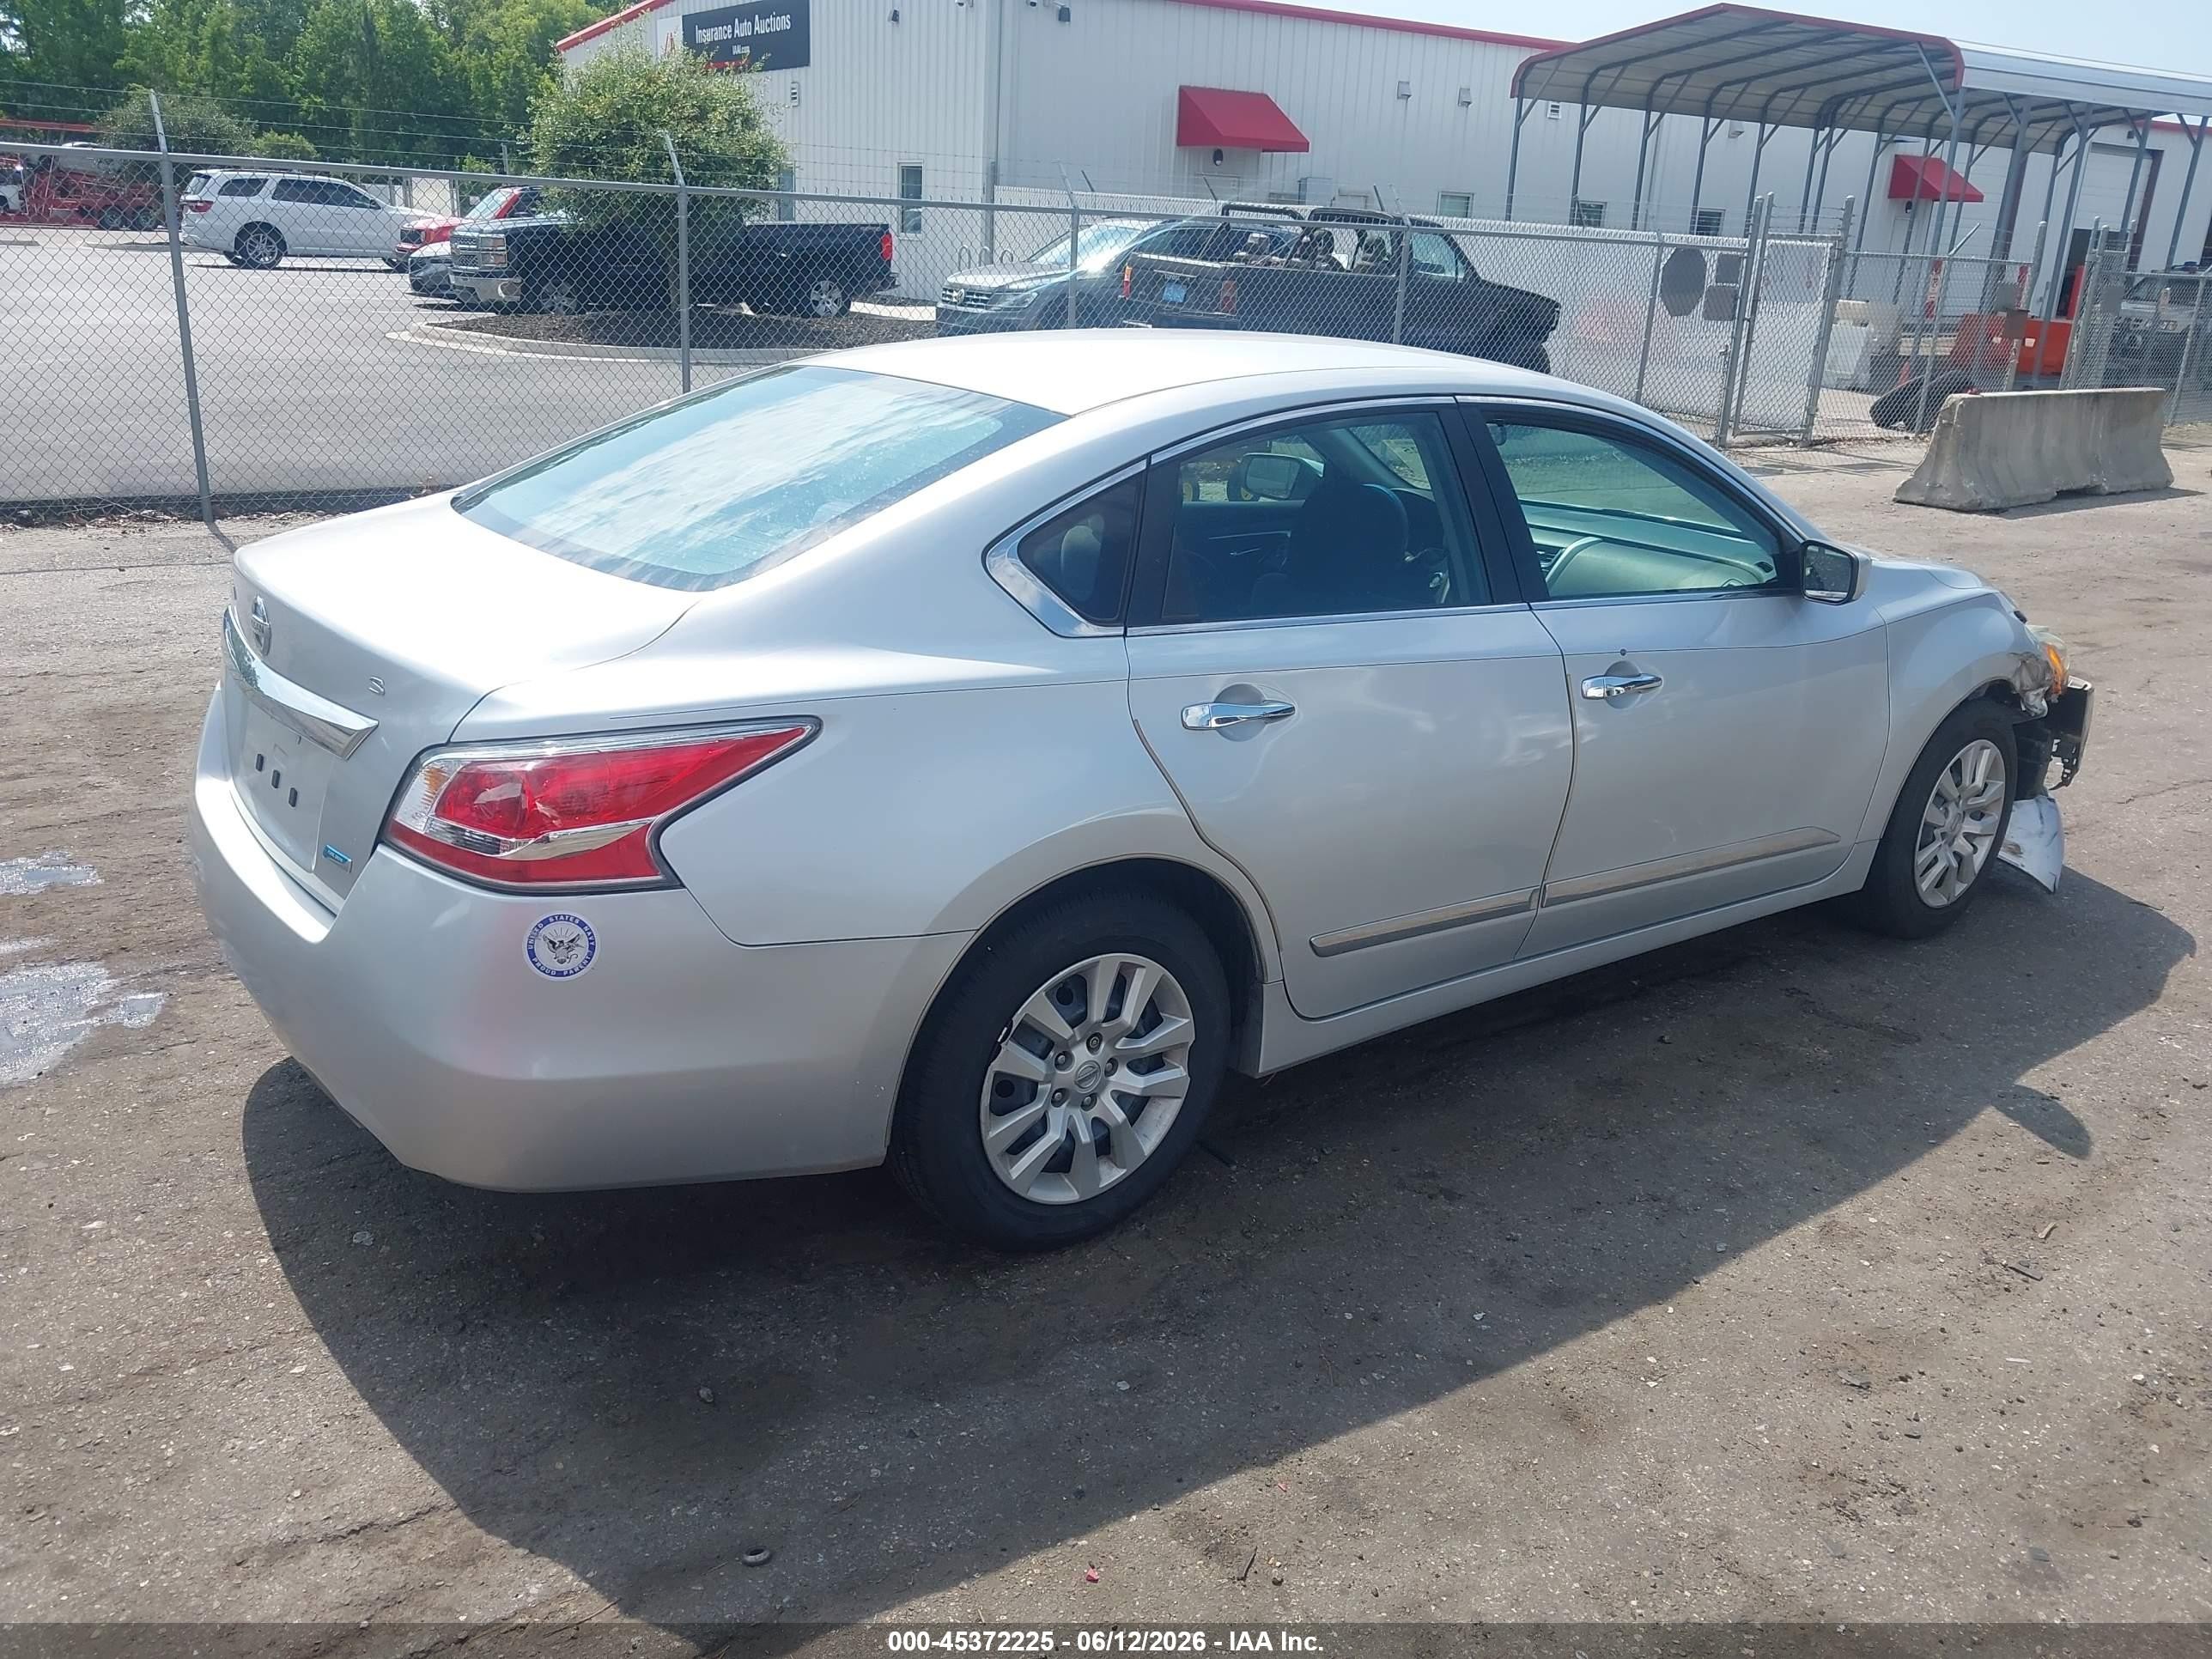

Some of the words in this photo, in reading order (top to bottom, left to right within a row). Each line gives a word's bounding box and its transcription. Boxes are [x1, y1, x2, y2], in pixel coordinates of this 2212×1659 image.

[695, 25, 732, 44] Insurance
[733, 18, 752, 38] Auto
[753, 12, 791, 34] Auctions
[368, 676, 385, 695] S
[527, 923, 544, 950] UNITED
[549, 915, 580, 925] STATES
[583, 926, 595, 946] NAVY
[532, 957, 556, 975] PROUD
[562, 956, 592, 975] PARENT
